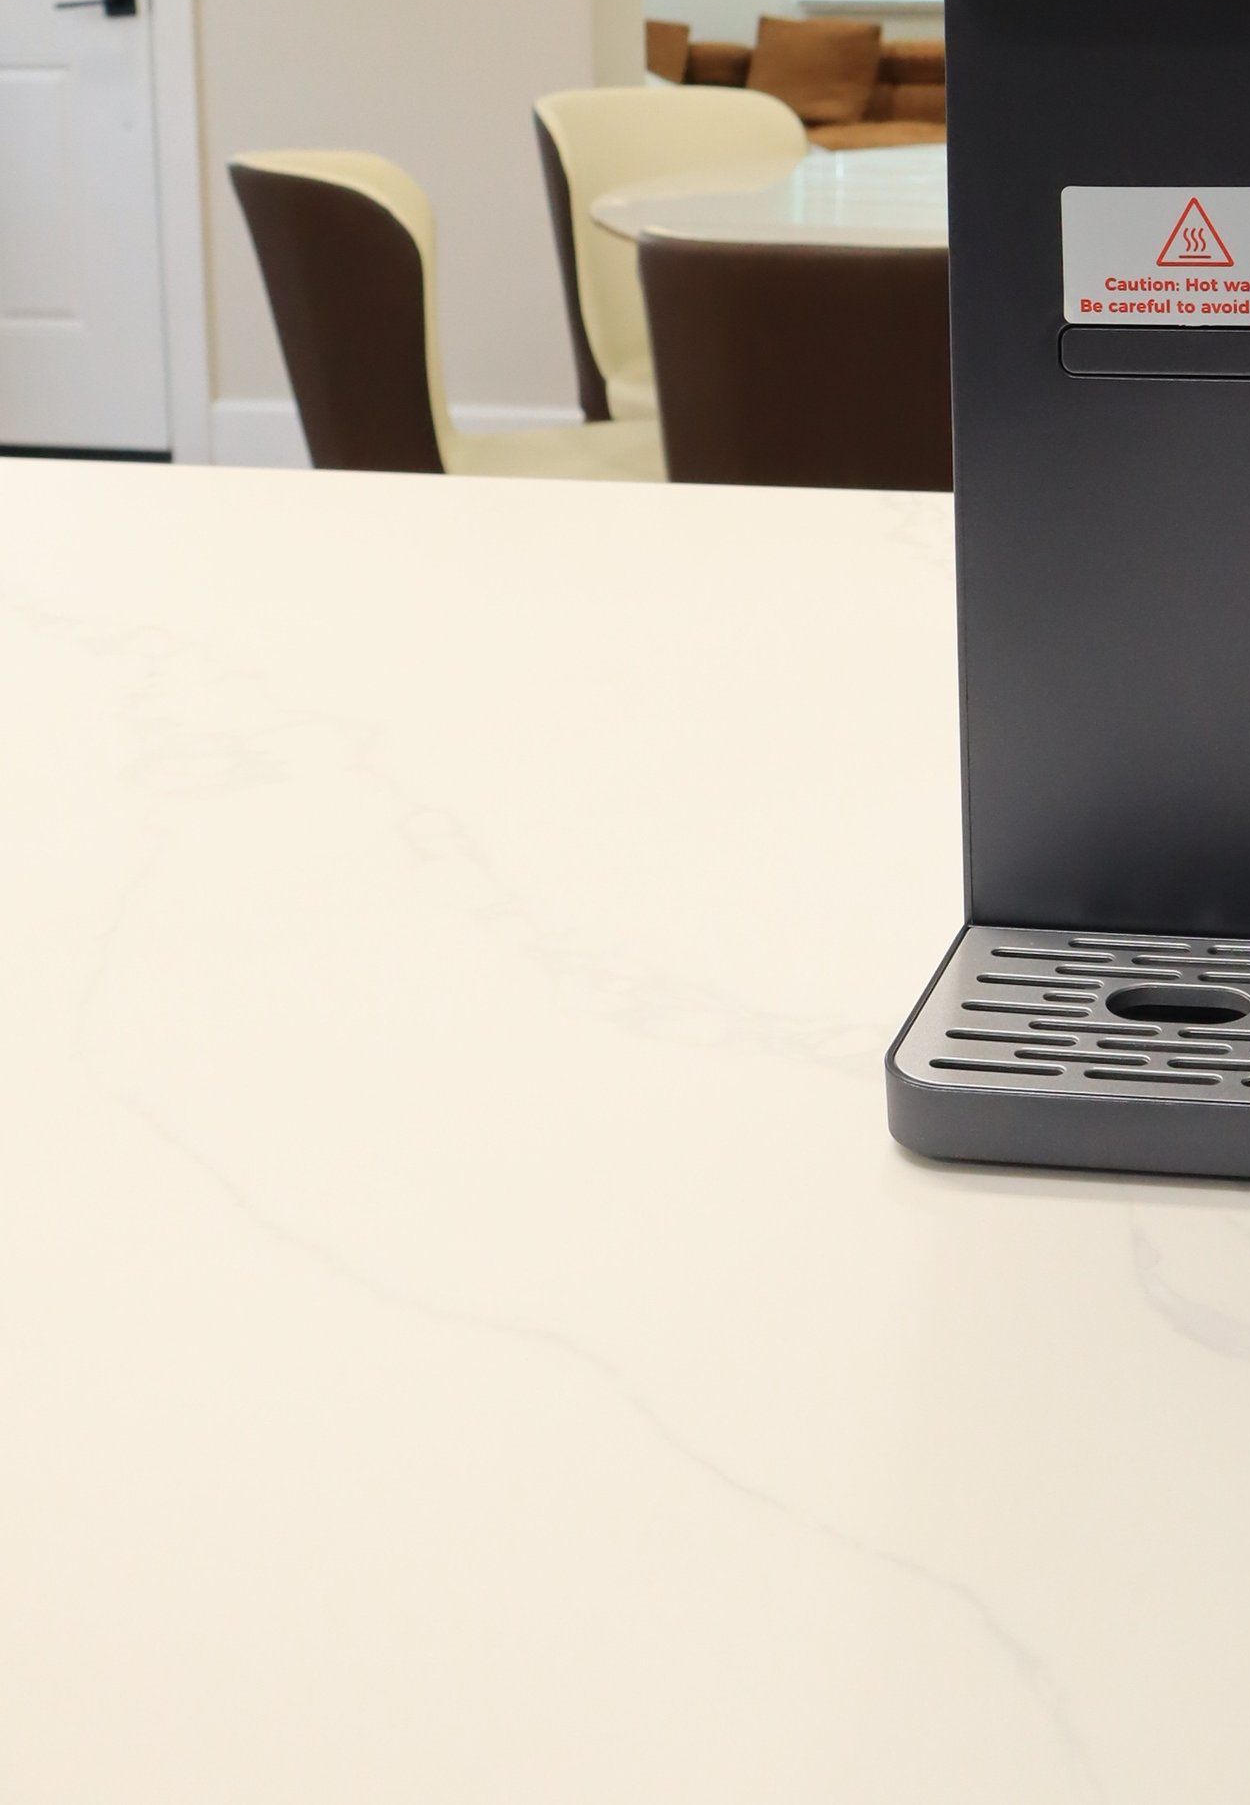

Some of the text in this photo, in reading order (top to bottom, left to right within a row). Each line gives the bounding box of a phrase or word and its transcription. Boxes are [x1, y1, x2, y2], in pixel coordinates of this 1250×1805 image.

[1105, 277, 1180, 292] Caution:
[1185, 278, 1218, 292] Hot
[1080, 299, 1103, 313] Be
[1108, 299, 1171, 314] careful
[1177, 301, 1195, 314] to
[1201, 299, 1250, 314] avoid
